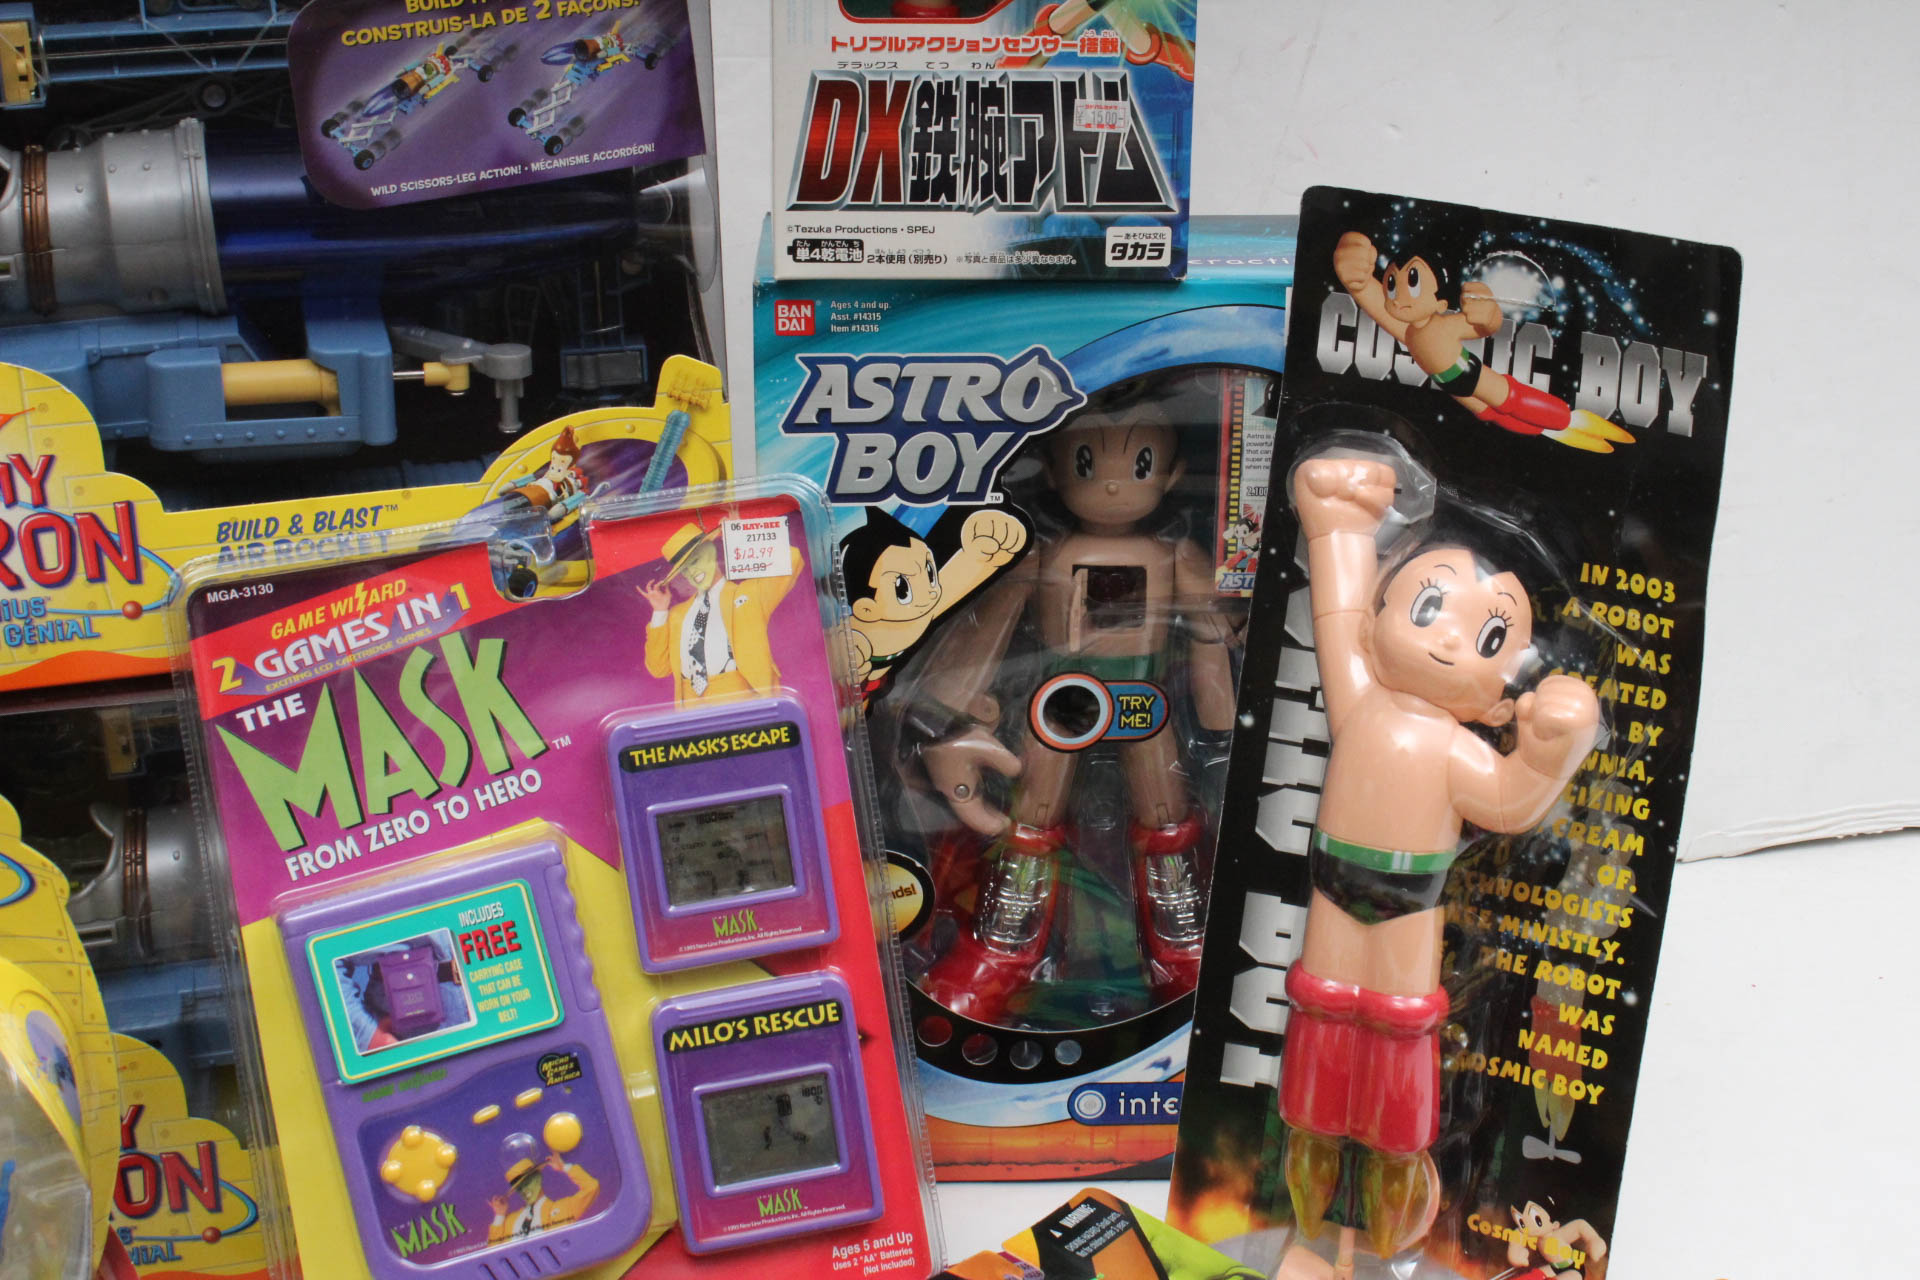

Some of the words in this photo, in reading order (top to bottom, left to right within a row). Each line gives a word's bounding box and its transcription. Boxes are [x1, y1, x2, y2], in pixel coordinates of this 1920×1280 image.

[341, 12, 497, 47] CONSTRUIS-LA
[501, 7, 528, 25] DE
[535, 0, 552, 21] 2
[371, 184, 398, 198] WILD
[400, 172, 476, 194] SCISSORS-LEG
[479, 164, 522, 182] ACTION!
[531, 153, 590, 174] MÉCANISME
[592, 142, 656, 163] ACCORDÉON!
[834, 224, 898, 234] Productions
[906, 225, 936, 234] SPEJ
[1110, 241, 1166, 261] タカラ
[777, 304, 812, 318] BAN
[830, 300, 852, 310] Ages
[853, 301, 859, 309] 4
[861, 300, 876, 309] and
[830, 312, 852, 321] Asst.
[853, 312, 882, 321] #14315
[777, 318, 806, 331] DAI
[830, 324, 849, 333] Item
[851, 324, 879, 333] #14316
[1316, 290, 1554, 392] COIC
[1576, 331, 1708, 438] BOY
[793, 353, 1074, 426] ASTRO
[831, 431, 1016, 498] BOY
[216, 515, 280, 544] BUILD
[289, 513, 305, 535] &
[312, 504, 384, 532] BLAST
[746, 532, 777, 542] 217133
[215, 540, 266, 572] AIR
[206, 581, 274, 603] MGA-3130
[1580, 562, 1610, 586] IN
[1616, 568, 1676, 604] 2003
[270, 605, 326, 641] GAME
[330, 578, 409, 621] WIZARD
[1562, 596, 1581, 618] A
[1590, 601, 1675, 640] ROBOT
[211, 656, 244, 694] 2
[253, 610, 391, 680] GAMES
[395, 596, 443, 631] IN
[449, 582, 472, 613] 1
[265, 668, 313, 693] EXCITING
[335, 642, 395, 670] CARTRIDGE
[395, 626, 433, 646] GAMES
[1615, 643, 1672, 676] WAS
[1118, 695, 1156, 712] TRY
[1549, 667, 1667, 711] EATED
[235, 691, 307, 734] THE
[1120, 711, 1153, 729] ME!
[214, 630, 551, 853] MASK
[629, 744, 667, 768] THE
[668, 734, 728, 762] MASK'S
[731, 725, 791, 751] ESCAPE
[1628, 720, 1664, 747] BY
[285, 833, 362, 883] FROM
[363, 808, 431, 854] ZERO
[432, 794, 471, 826] TO
[473, 767, 543, 813] HERO
[1552, 817, 1645, 857] CREAM
[1597, 864, 1638, 894] OF.
[458, 901, 505, 929] INCLUDES
[711, 908, 758, 938] MASK
[458, 920, 522, 965] FREE
[1498, 914, 1625, 966] MINISTLY.
[1533, 959, 1622, 1000] ROBOT
[668, 1018, 749, 1053] MILO'S
[754, 1001, 841, 1038] RESCUE
[1558, 1002, 1616, 1036] WAS
[1517, 1028, 1609, 1071] NAMED
[1552, 1073, 1605, 1106] BOY
[756, 1187, 803, 1218] MASK
[390, 1202, 467, 1259] MASK
[832, 1243, 861, 1260] Ages
[863, 1239, 871, 1252] 5
[873, 1234, 895, 1250] and
[896, 1231, 914, 1246] Up
[832, 1259, 852, 1271] Uses
[853, 1258, 859, 1266] 2
[879, 1247, 913, 1260] Batteries
[863, 1264, 880, 1277] (Not
[881, 1257, 916, 1272] Included)
